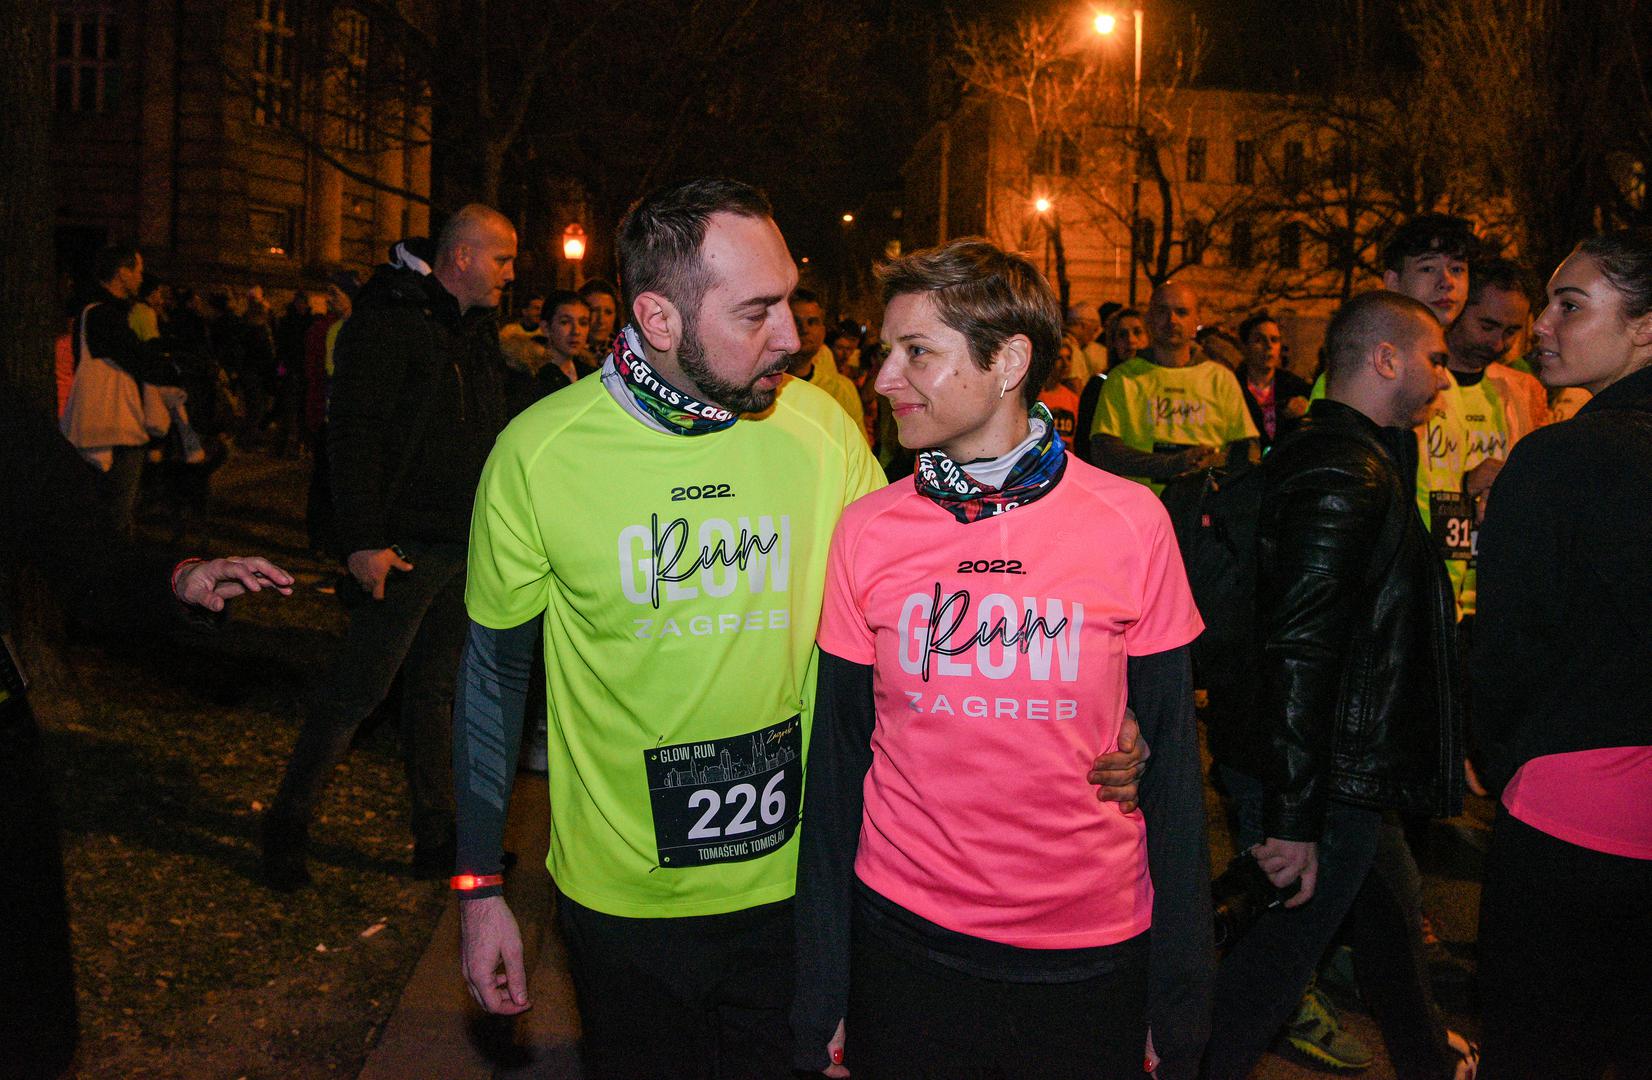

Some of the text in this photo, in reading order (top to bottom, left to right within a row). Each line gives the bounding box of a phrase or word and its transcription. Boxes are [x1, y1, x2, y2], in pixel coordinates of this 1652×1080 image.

[683, 400, 734, 422] Zag
[670, 483, 736, 502] 2022.
[617, 514, 791, 605] GLOW
[651, 512, 779, 610] Run
[956, 559, 1027, 575] 2022.
[632, 608, 791, 640] ZAGREB
[897, 592, 1085, 682] GLOW
[921, 582, 1068, 683] Run
[903, 690, 1079, 721] ZAGREB
[660, 743, 716, 764] GLOW RUN
[687, 769, 786, 840] 226
[698, 828, 786, 861] TOMAŠEVIĆ TOMISLAV
